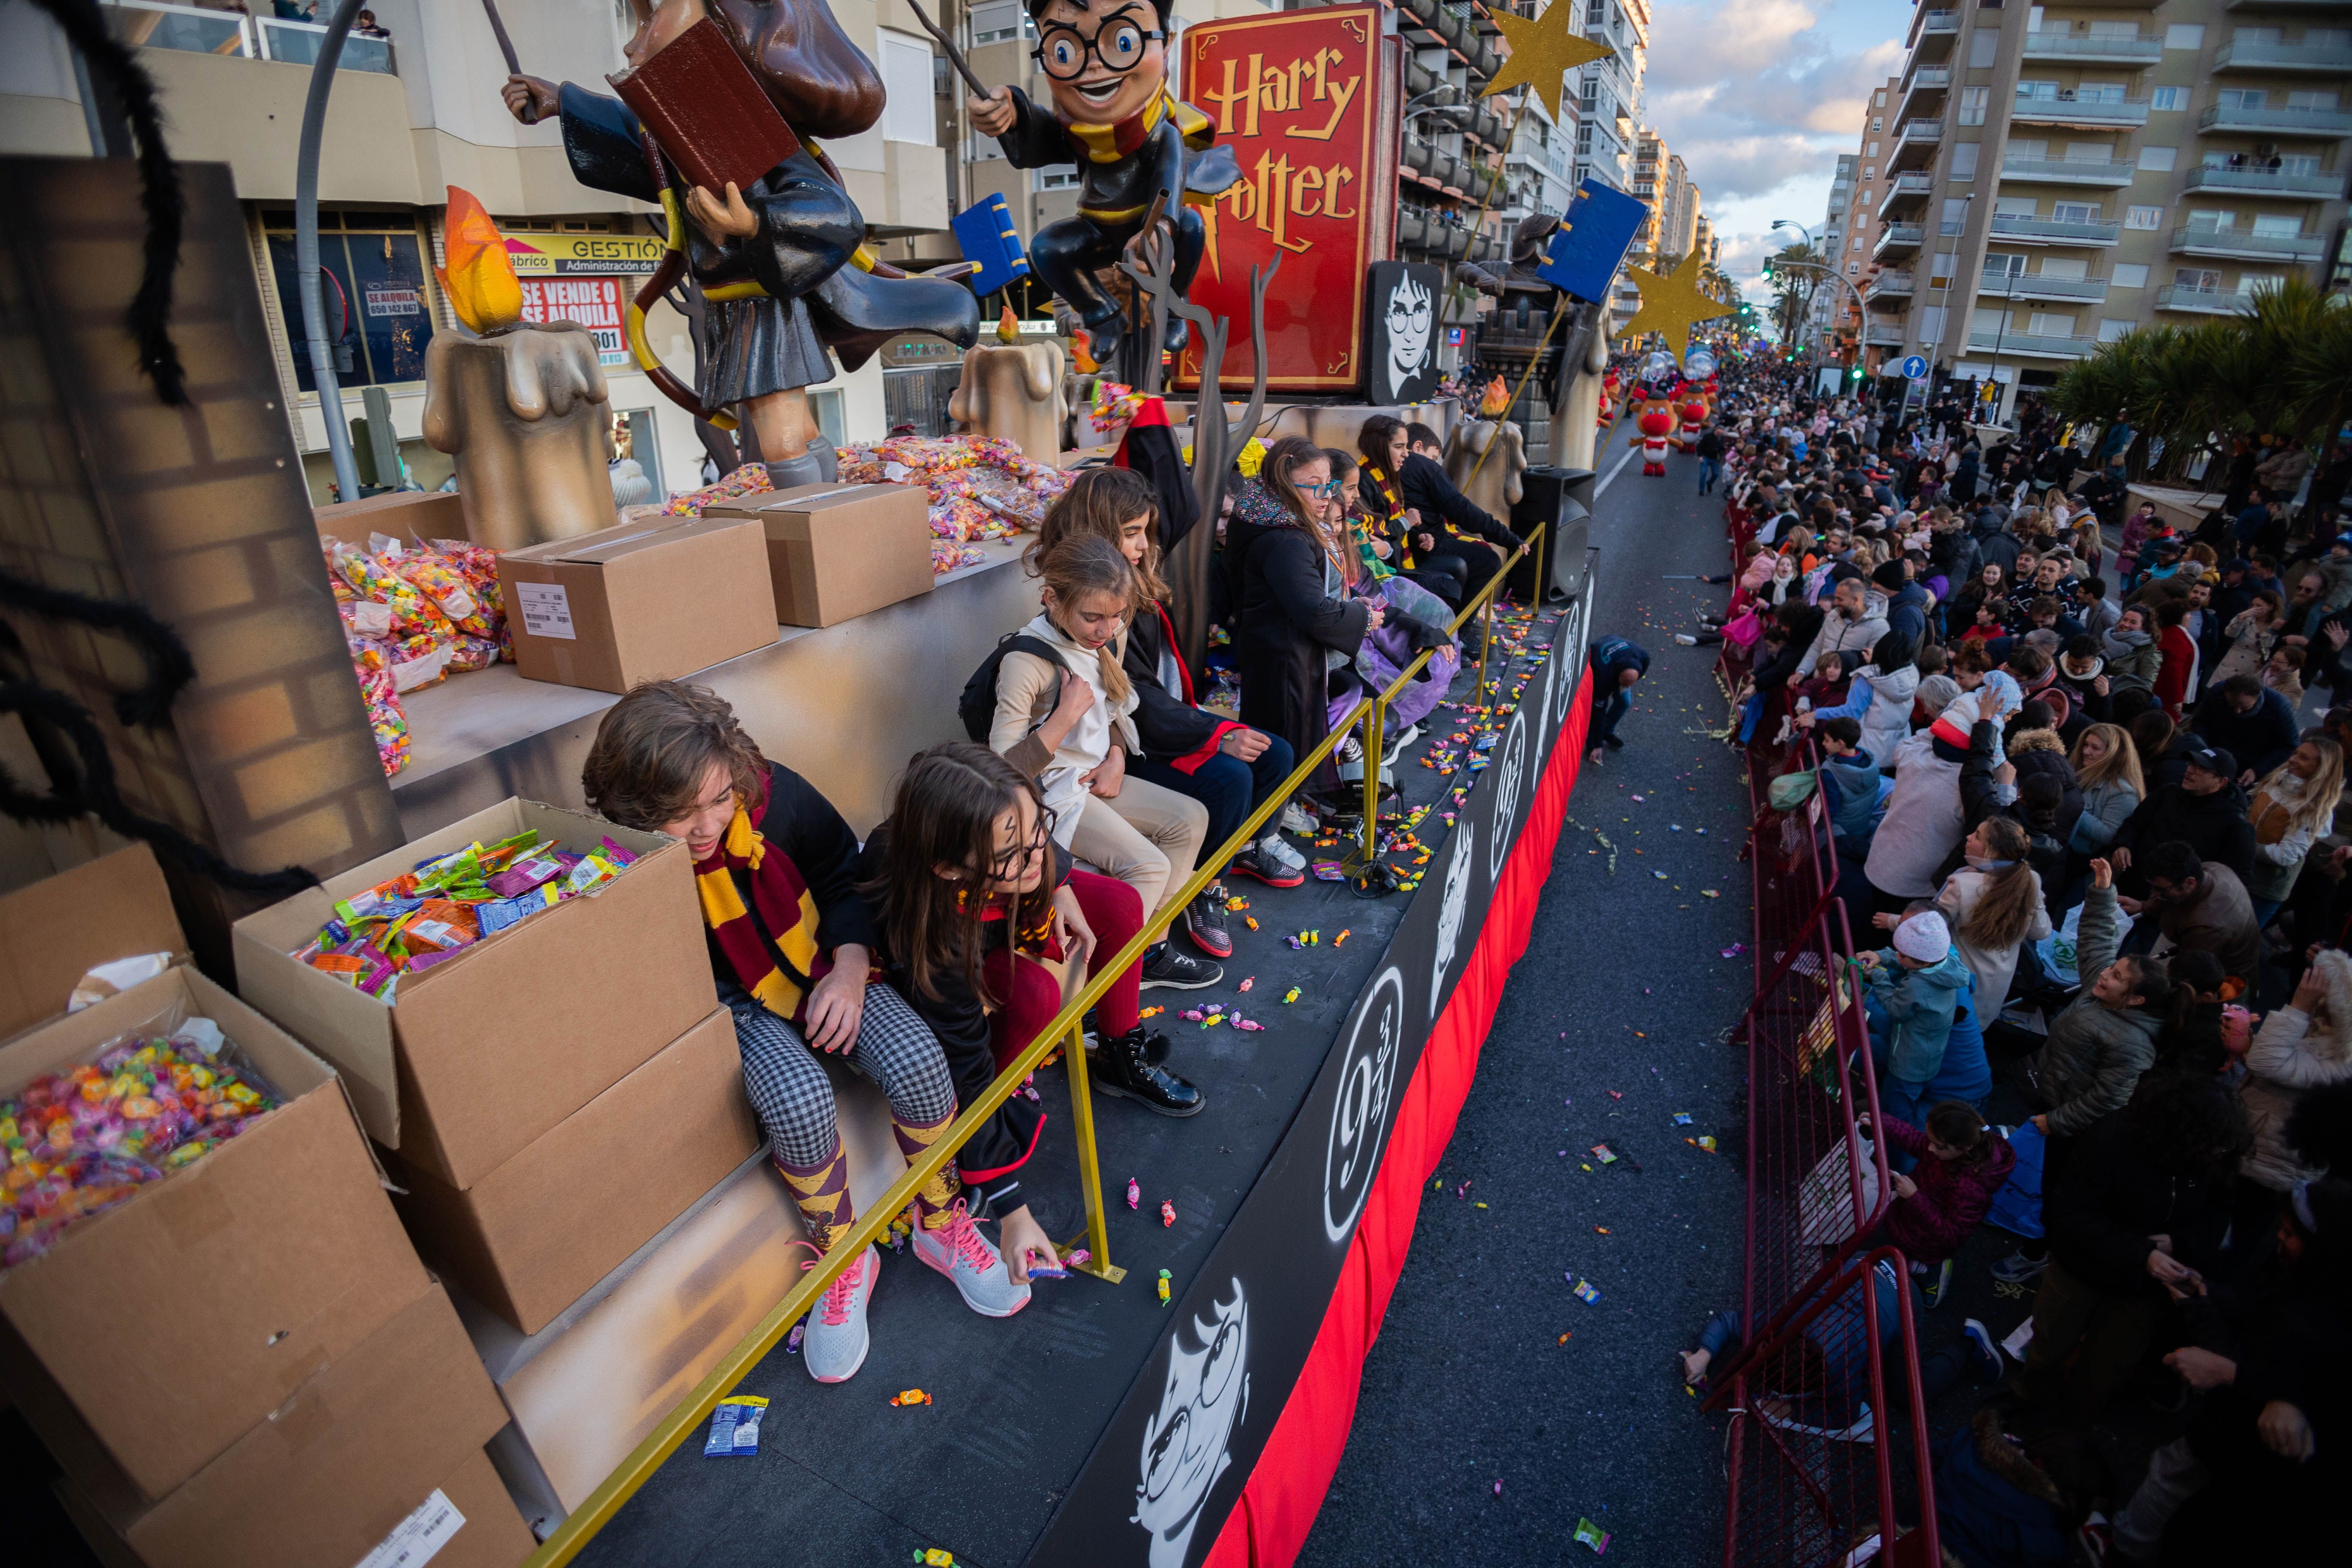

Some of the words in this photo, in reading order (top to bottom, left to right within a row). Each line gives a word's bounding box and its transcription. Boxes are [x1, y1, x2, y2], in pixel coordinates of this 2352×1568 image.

[1203, 47, 1362, 142] Harry
[510, 255, 548, 266] ábrico
[566, 260, 639, 271] Administración
[640, 260, 652, 271] de
[368, 293, 379, 303] SE
[381, 292, 415, 303] ALQUILA
[520, 282, 542, 306] SE
[543, 281, 602, 306] VENDE
[603, 281, 616, 304] O
[371, 305, 386, 314] 650
[388, 304, 401, 314] 142
[403, 304, 417, 312] 867
[521, 306, 545, 323] SE
[548, 303, 620, 327] ALQUILA
